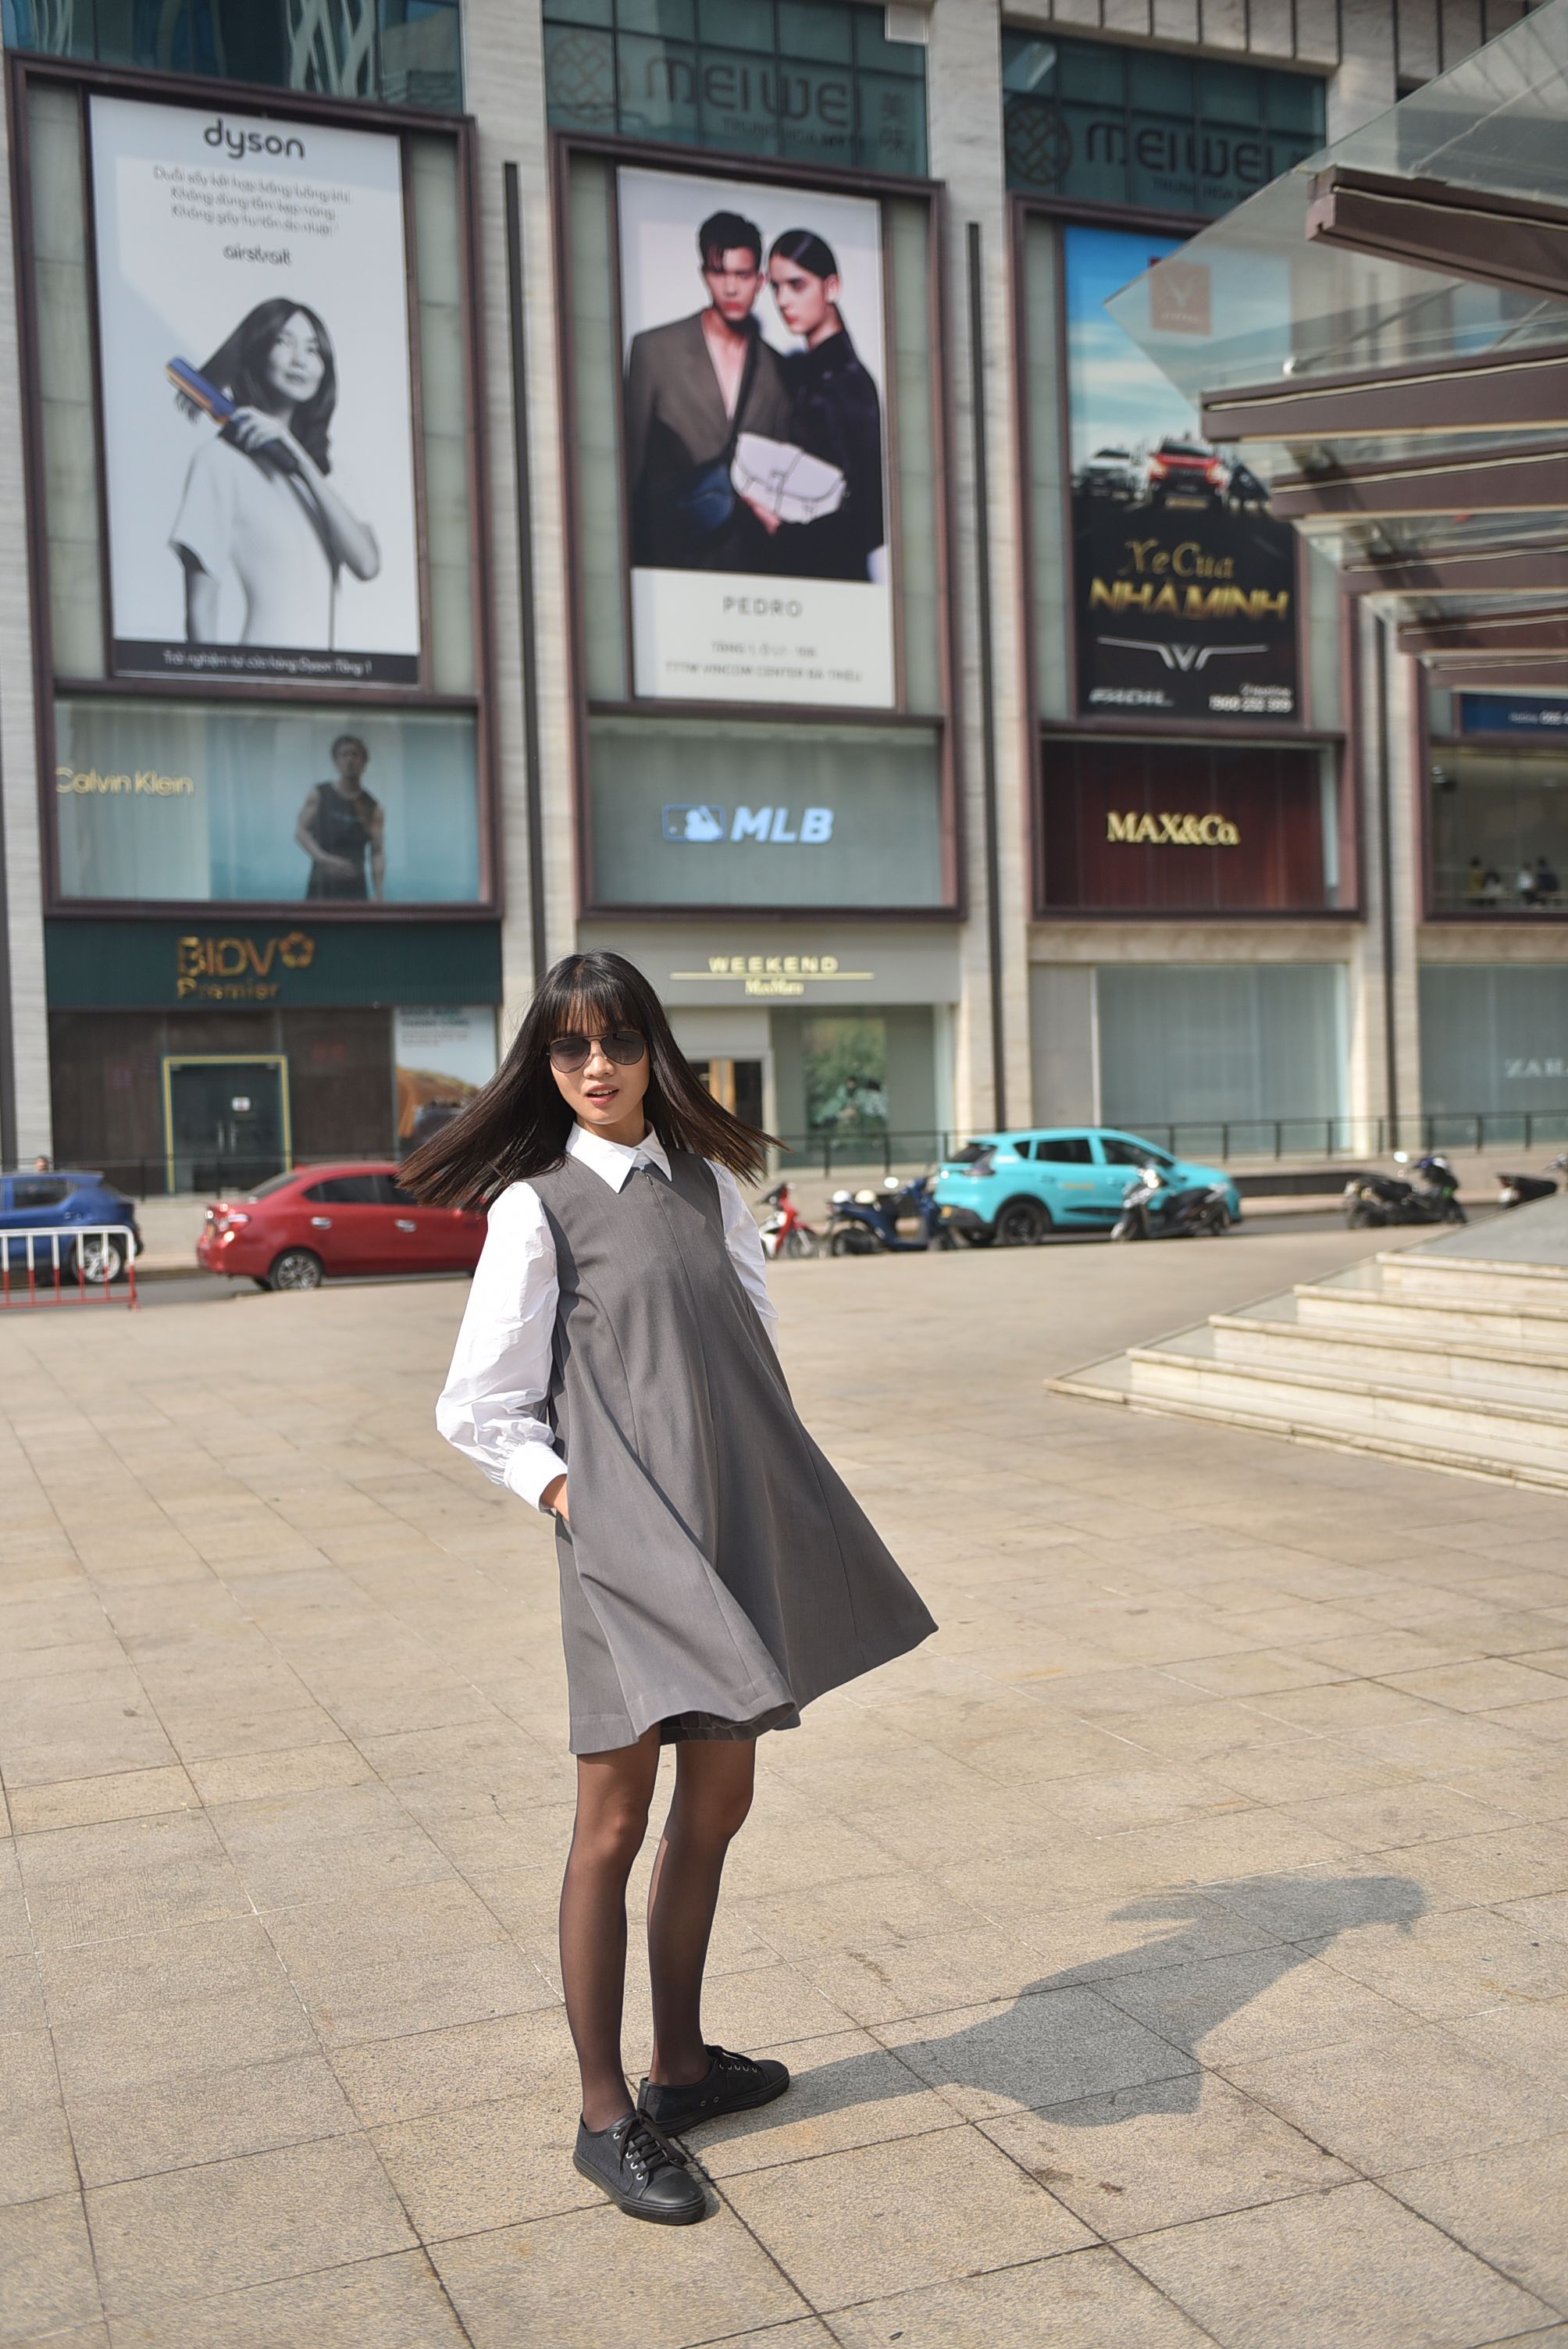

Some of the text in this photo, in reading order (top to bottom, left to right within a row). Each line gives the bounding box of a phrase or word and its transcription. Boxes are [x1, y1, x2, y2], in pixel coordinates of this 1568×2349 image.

[204, 117, 305, 160] dyson
[723, 596, 804, 618] PEDRO
[55, 766, 194, 797] Calvin Klein
[730, 806, 835, 843] MLB
[177, 936, 277, 976] BIDV
[708, 956, 839, 973] WEEKEND
[177, 976, 280, 1000] Premier
[1504, 1057, 1568, 1078] ZAR
